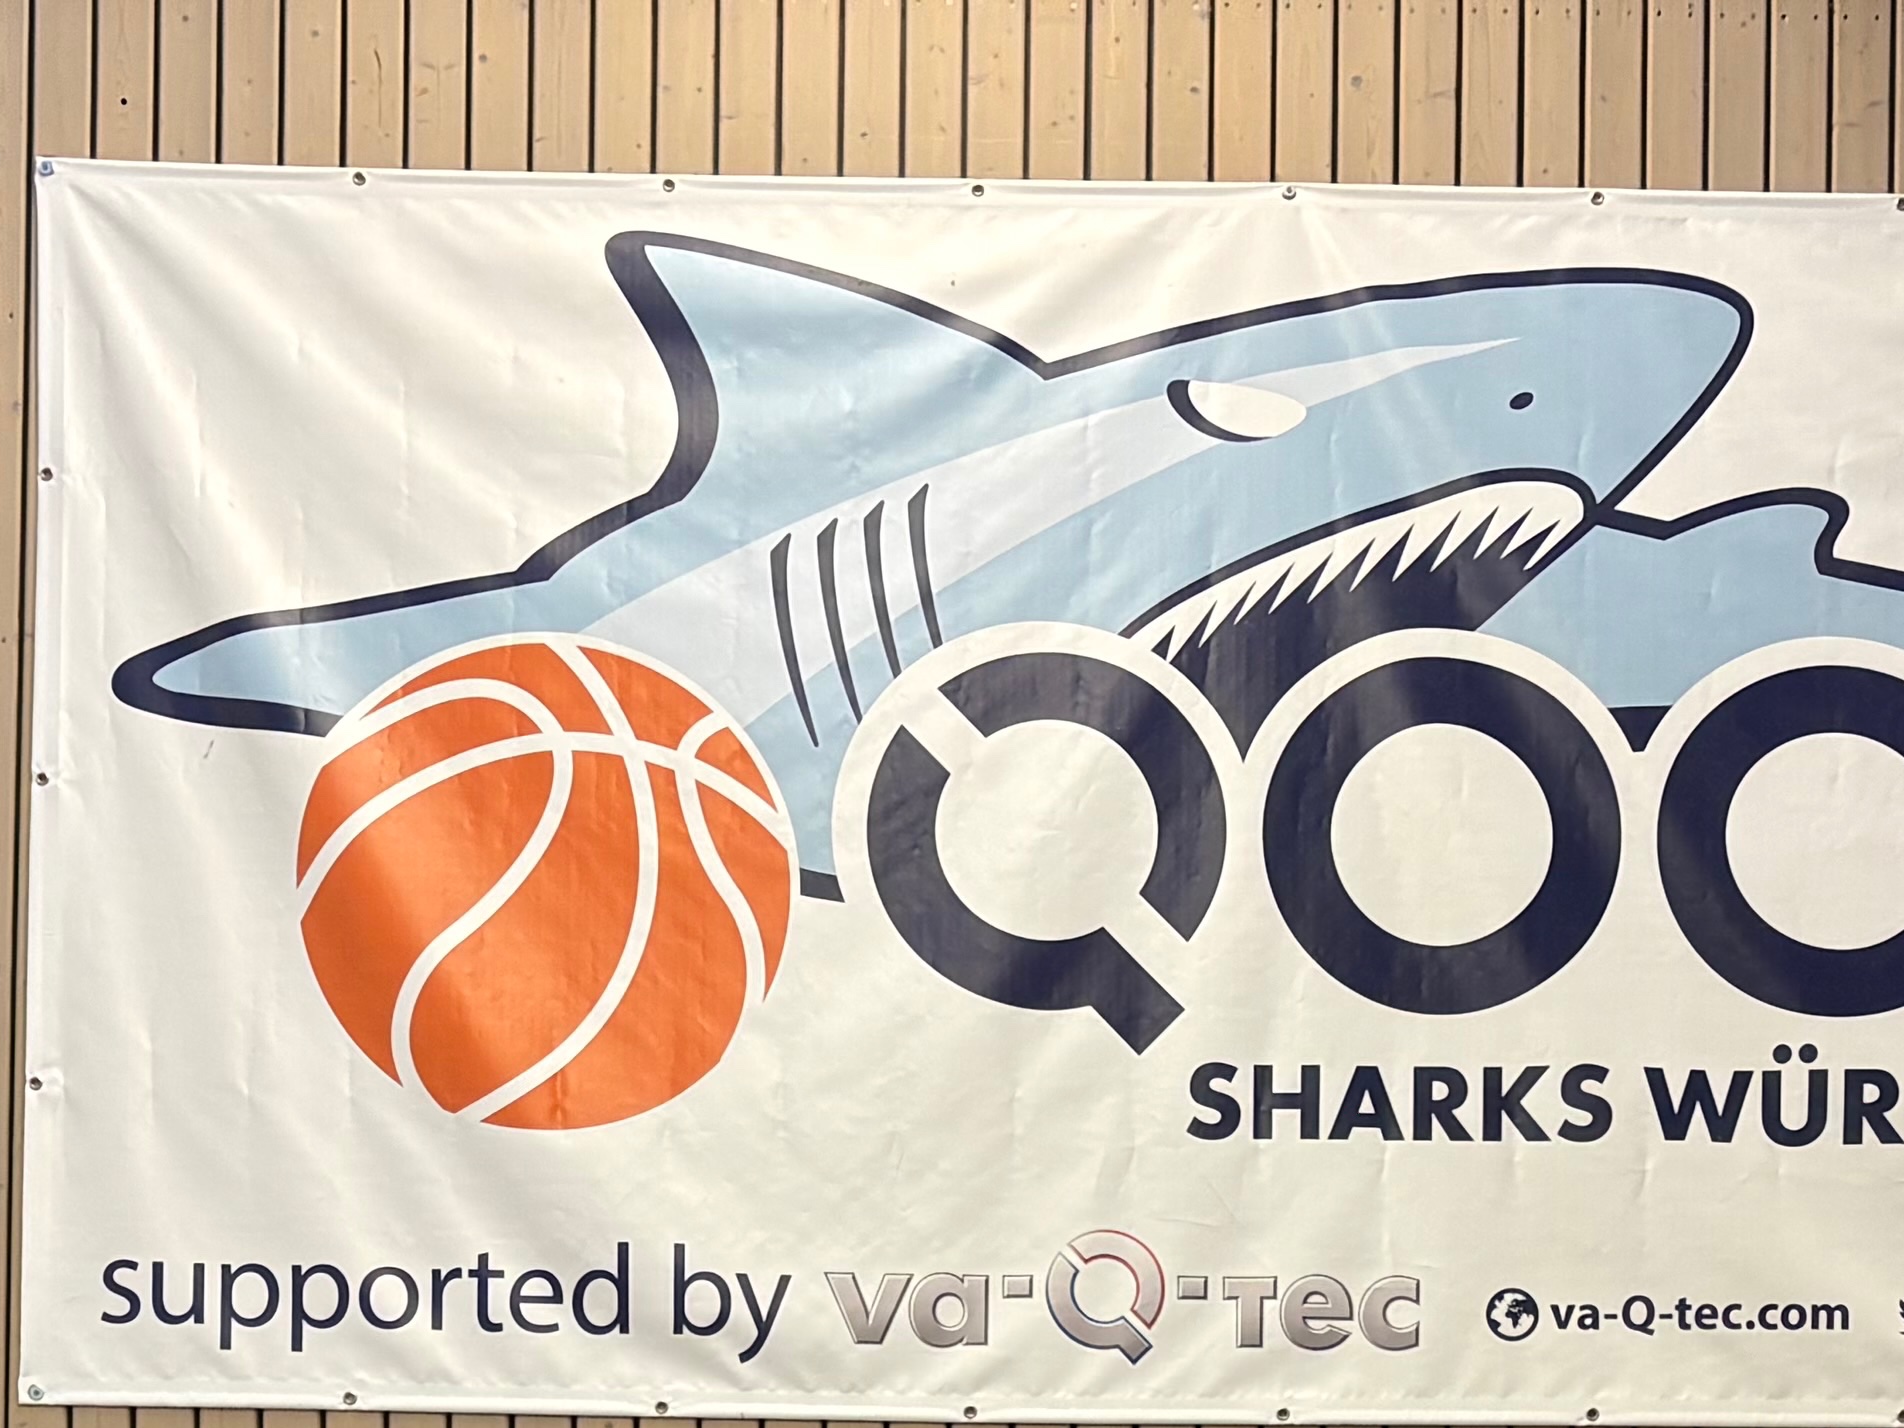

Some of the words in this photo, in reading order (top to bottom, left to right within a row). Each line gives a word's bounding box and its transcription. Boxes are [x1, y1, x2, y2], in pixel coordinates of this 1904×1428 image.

[1186, 1062, 1613, 1142] SHARKS
[99, 1241, 631, 1354] supported
[671, 1242, 792, 1363] by
[1550, 1293, 1851, 1340] va-Q-tec.com
